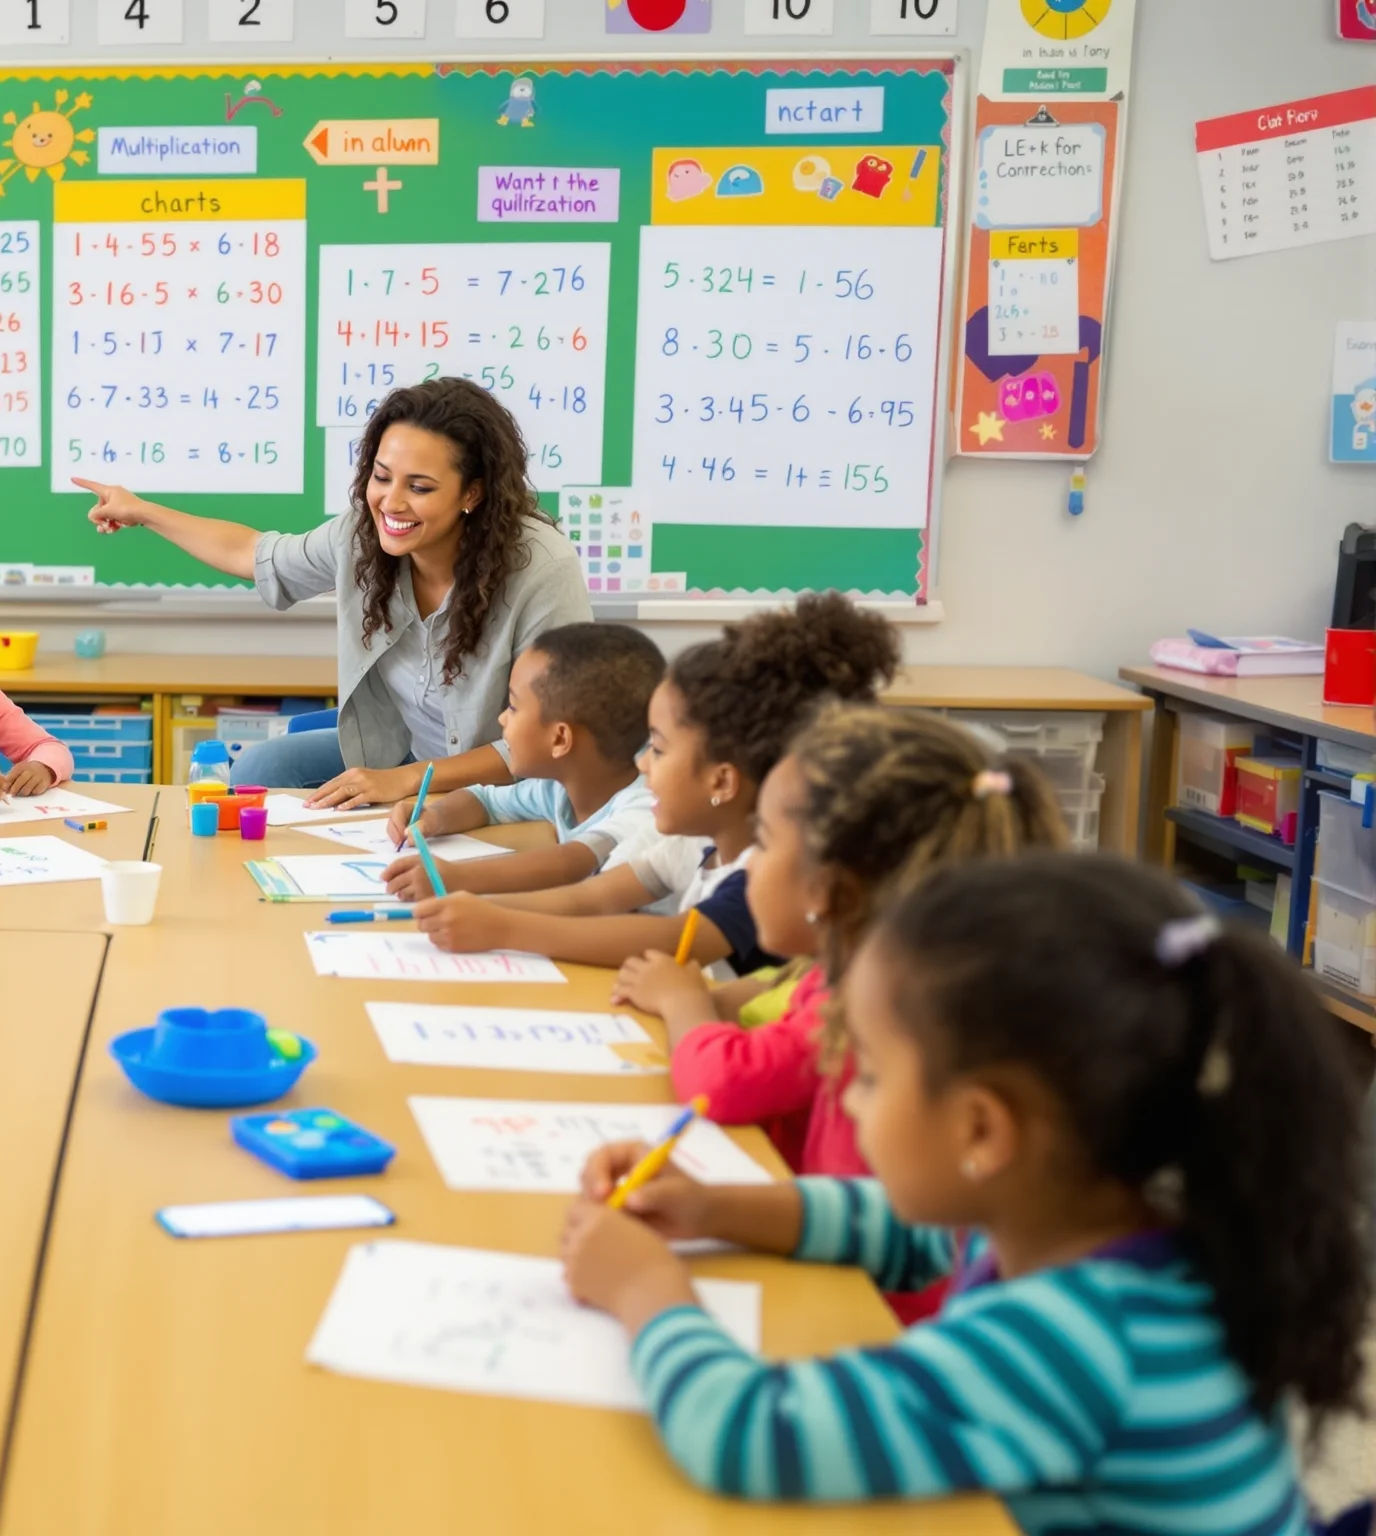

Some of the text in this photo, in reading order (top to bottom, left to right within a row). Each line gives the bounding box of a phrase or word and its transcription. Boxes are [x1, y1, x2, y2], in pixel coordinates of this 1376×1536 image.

[124, 0, 150, 30] 4
[238, 0, 261, 26] 2
[375, 0, 398, 26] 5
[778, 99, 863, 123] nctart
[110, 135, 241, 162] Multiplication
[343, 130, 364, 153] in
[1055, 136, 1082, 156] for
[495, 171, 546, 192] Want
[566, 172, 600, 192] the
[140, 190, 222, 214] charts
